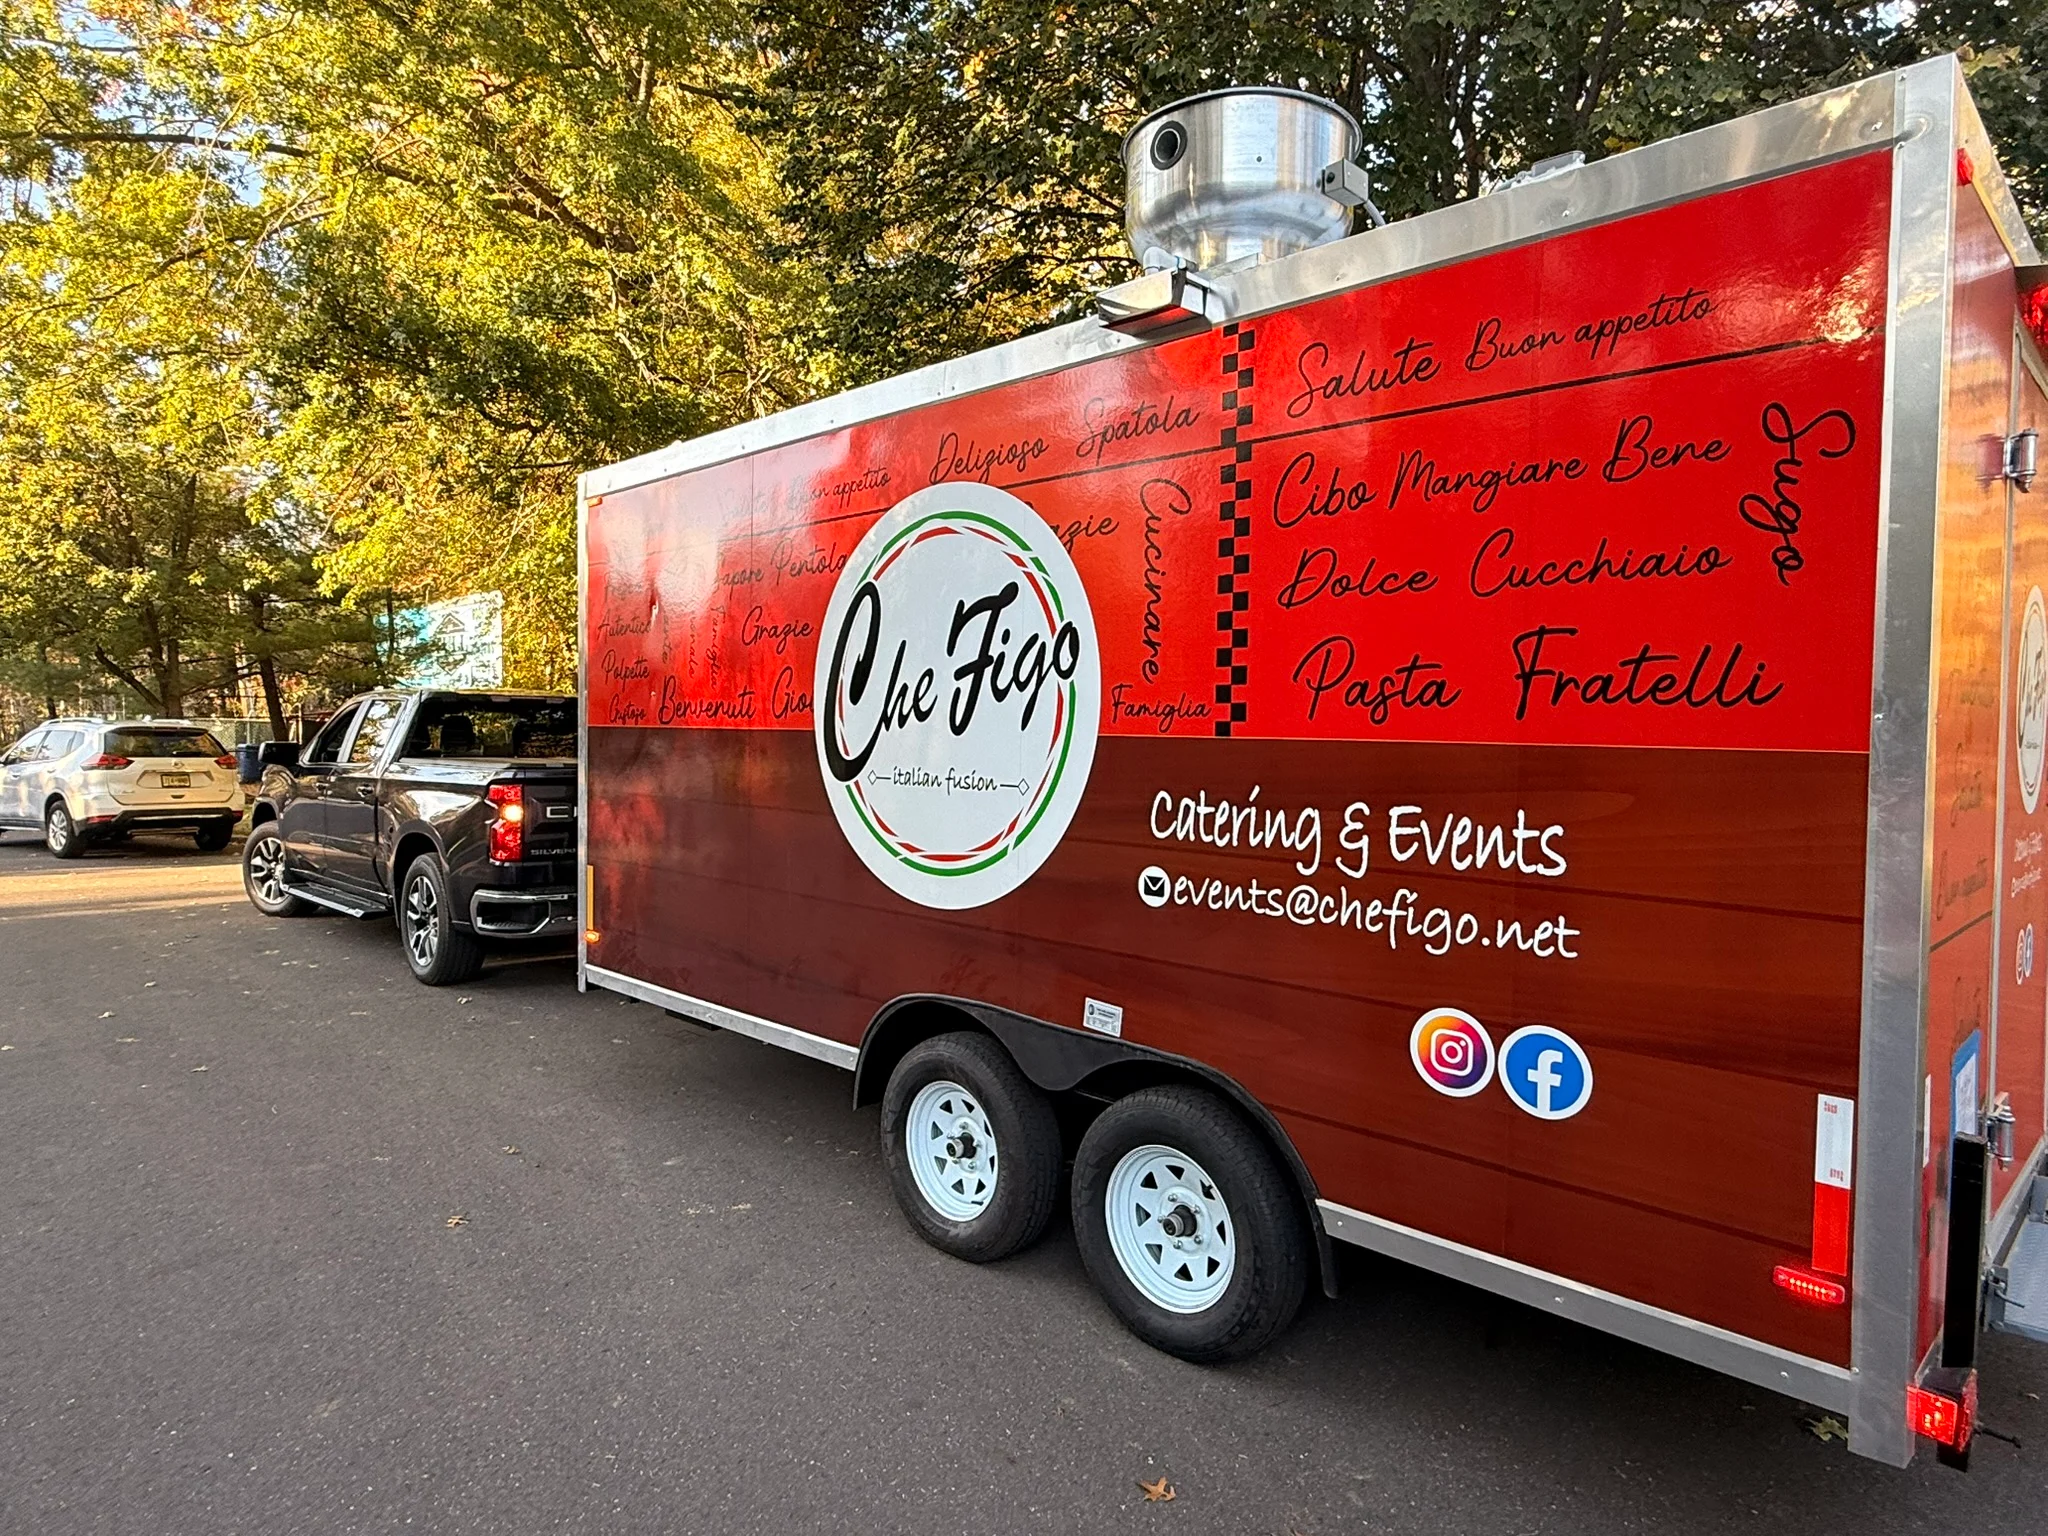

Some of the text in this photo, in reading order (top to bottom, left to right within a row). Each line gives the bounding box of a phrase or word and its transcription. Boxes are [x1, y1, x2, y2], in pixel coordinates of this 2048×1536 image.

[1286, 287, 1718, 419] Salute Buon appetito
[928, 395, 1200, 484] Delizioso Spatola
[1272, 414, 1734, 529] Cibo Mangiare Bene
[833, 464, 891, 509] appetito
[1739, 401, 1857, 588] Sugo
[770, 537, 848, 586] Pentola
[1139, 477, 1192, 685] Cucinare
[1276, 527, 1733, 610] Dolce Cucchiaio
[741, 605, 814, 655] Grazie
[658, 675, 756, 724] Benvenuti
[823, 580, 938, 783] Che
[947, 581, 1080, 736] Figo
[1110, 682, 1212, 732] Famiglia
[1291, 624, 1785, 725] Pasta Fratelli
[892, 766, 997, 796] italian fusion
[1150, 786, 1568, 878] Catering & Events
[1173, 872, 1580, 959] events@chefigo.net
